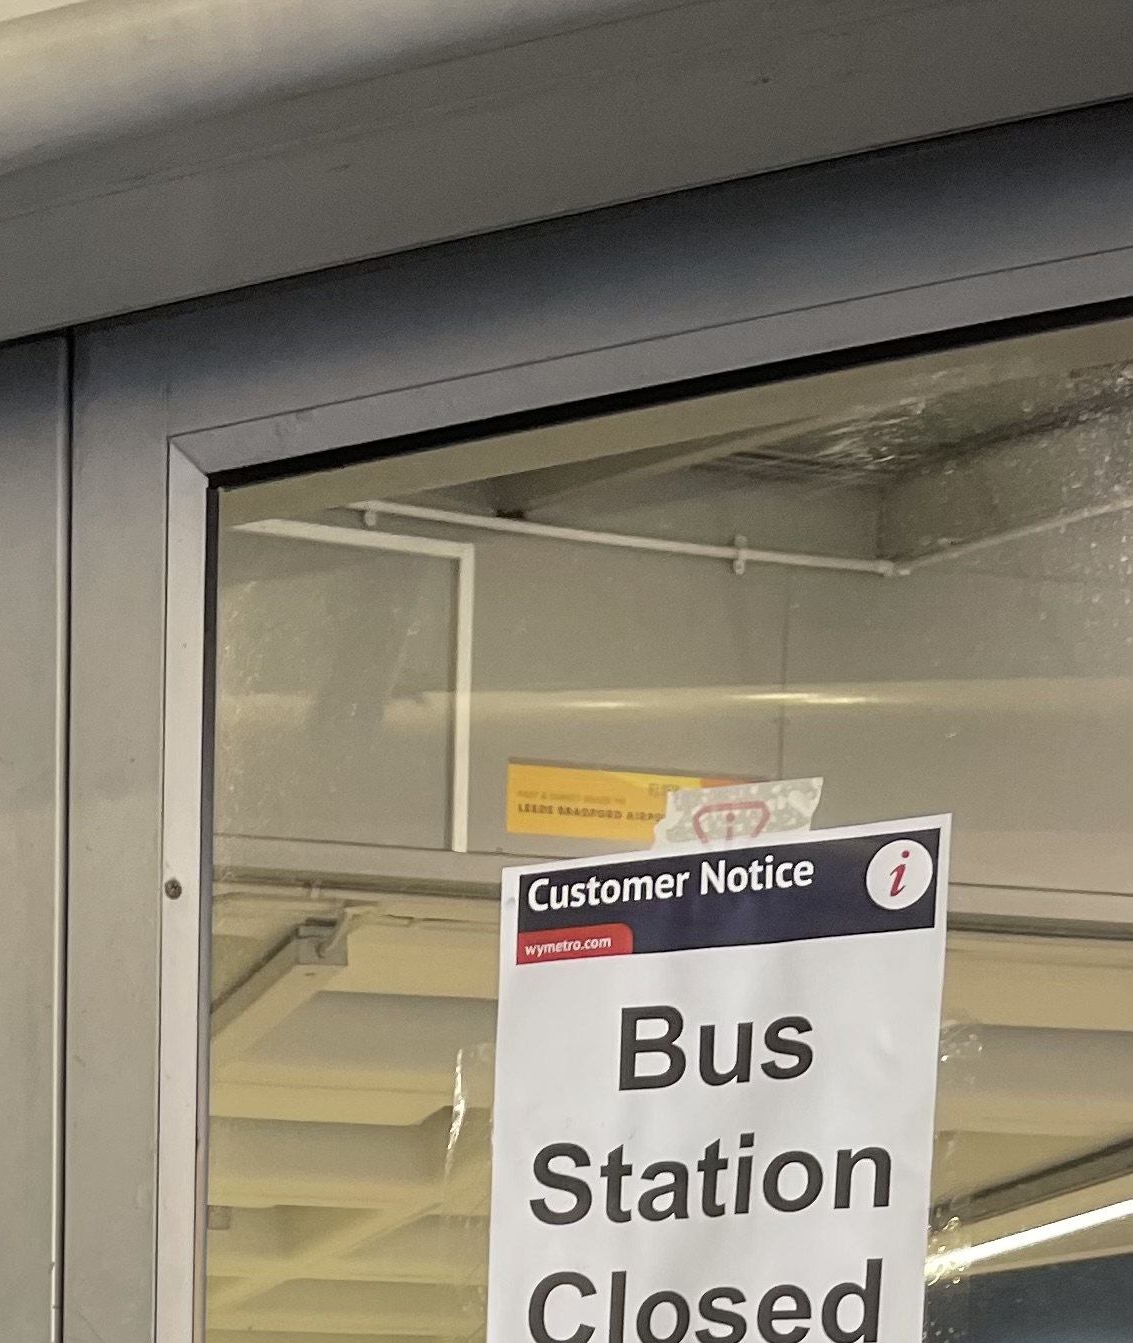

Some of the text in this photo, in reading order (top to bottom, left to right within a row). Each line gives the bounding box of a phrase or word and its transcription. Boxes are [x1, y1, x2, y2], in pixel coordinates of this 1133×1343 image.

[528, 854, 815, 912] Customer Notice
[524, 937, 612, 958] wymetro.com
[618, 1005, 814, 1092] Bus
[529, 1131, 892, 1226] Station
